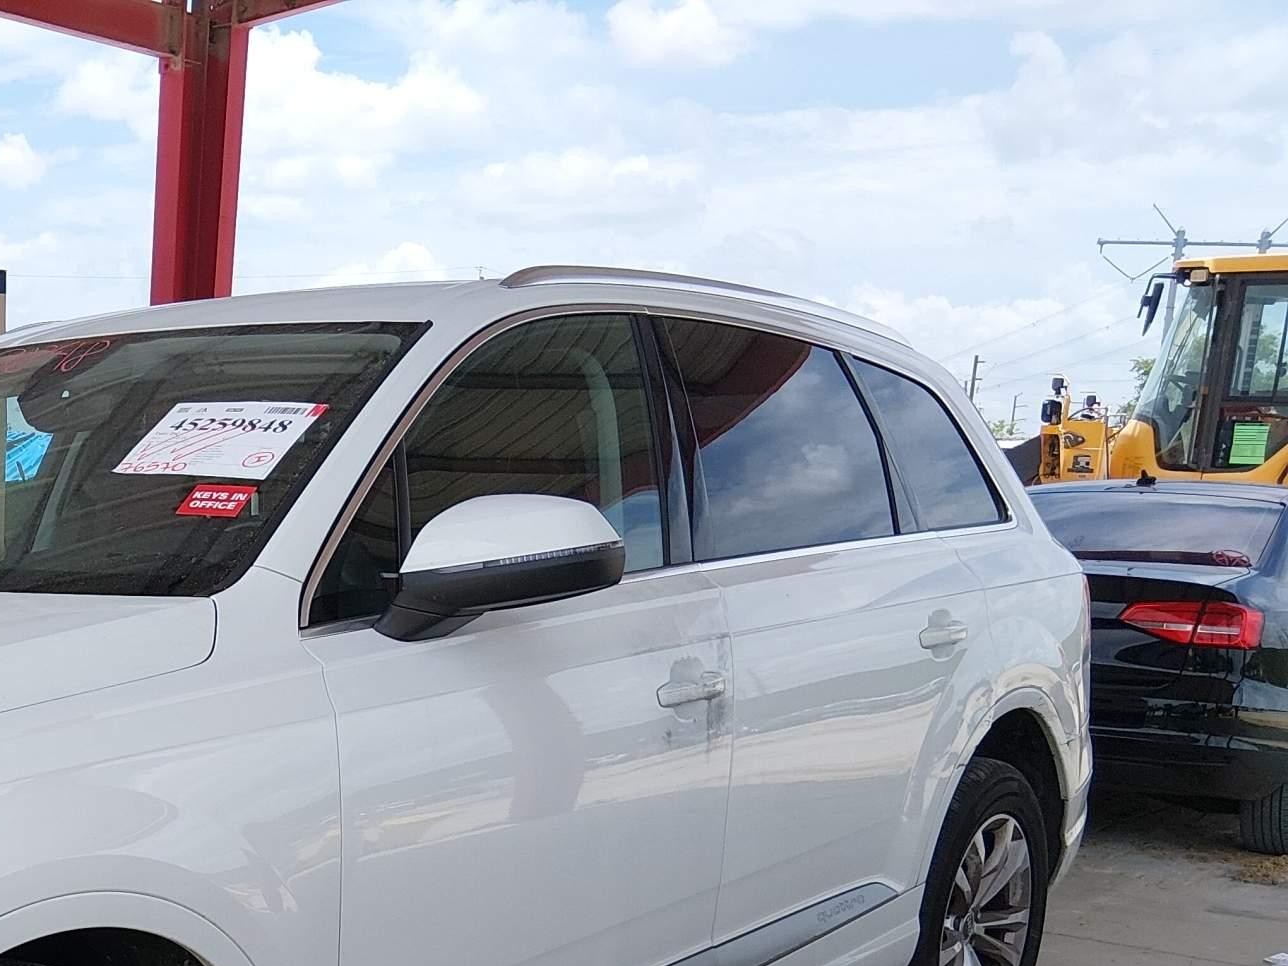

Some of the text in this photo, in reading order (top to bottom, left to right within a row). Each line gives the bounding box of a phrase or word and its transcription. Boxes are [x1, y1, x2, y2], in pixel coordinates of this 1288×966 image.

[170, 418, 293, 434] 45259848
[192, 491, 248, 501] KEYS IN
[189, 500, 238, 510] OFFICE
